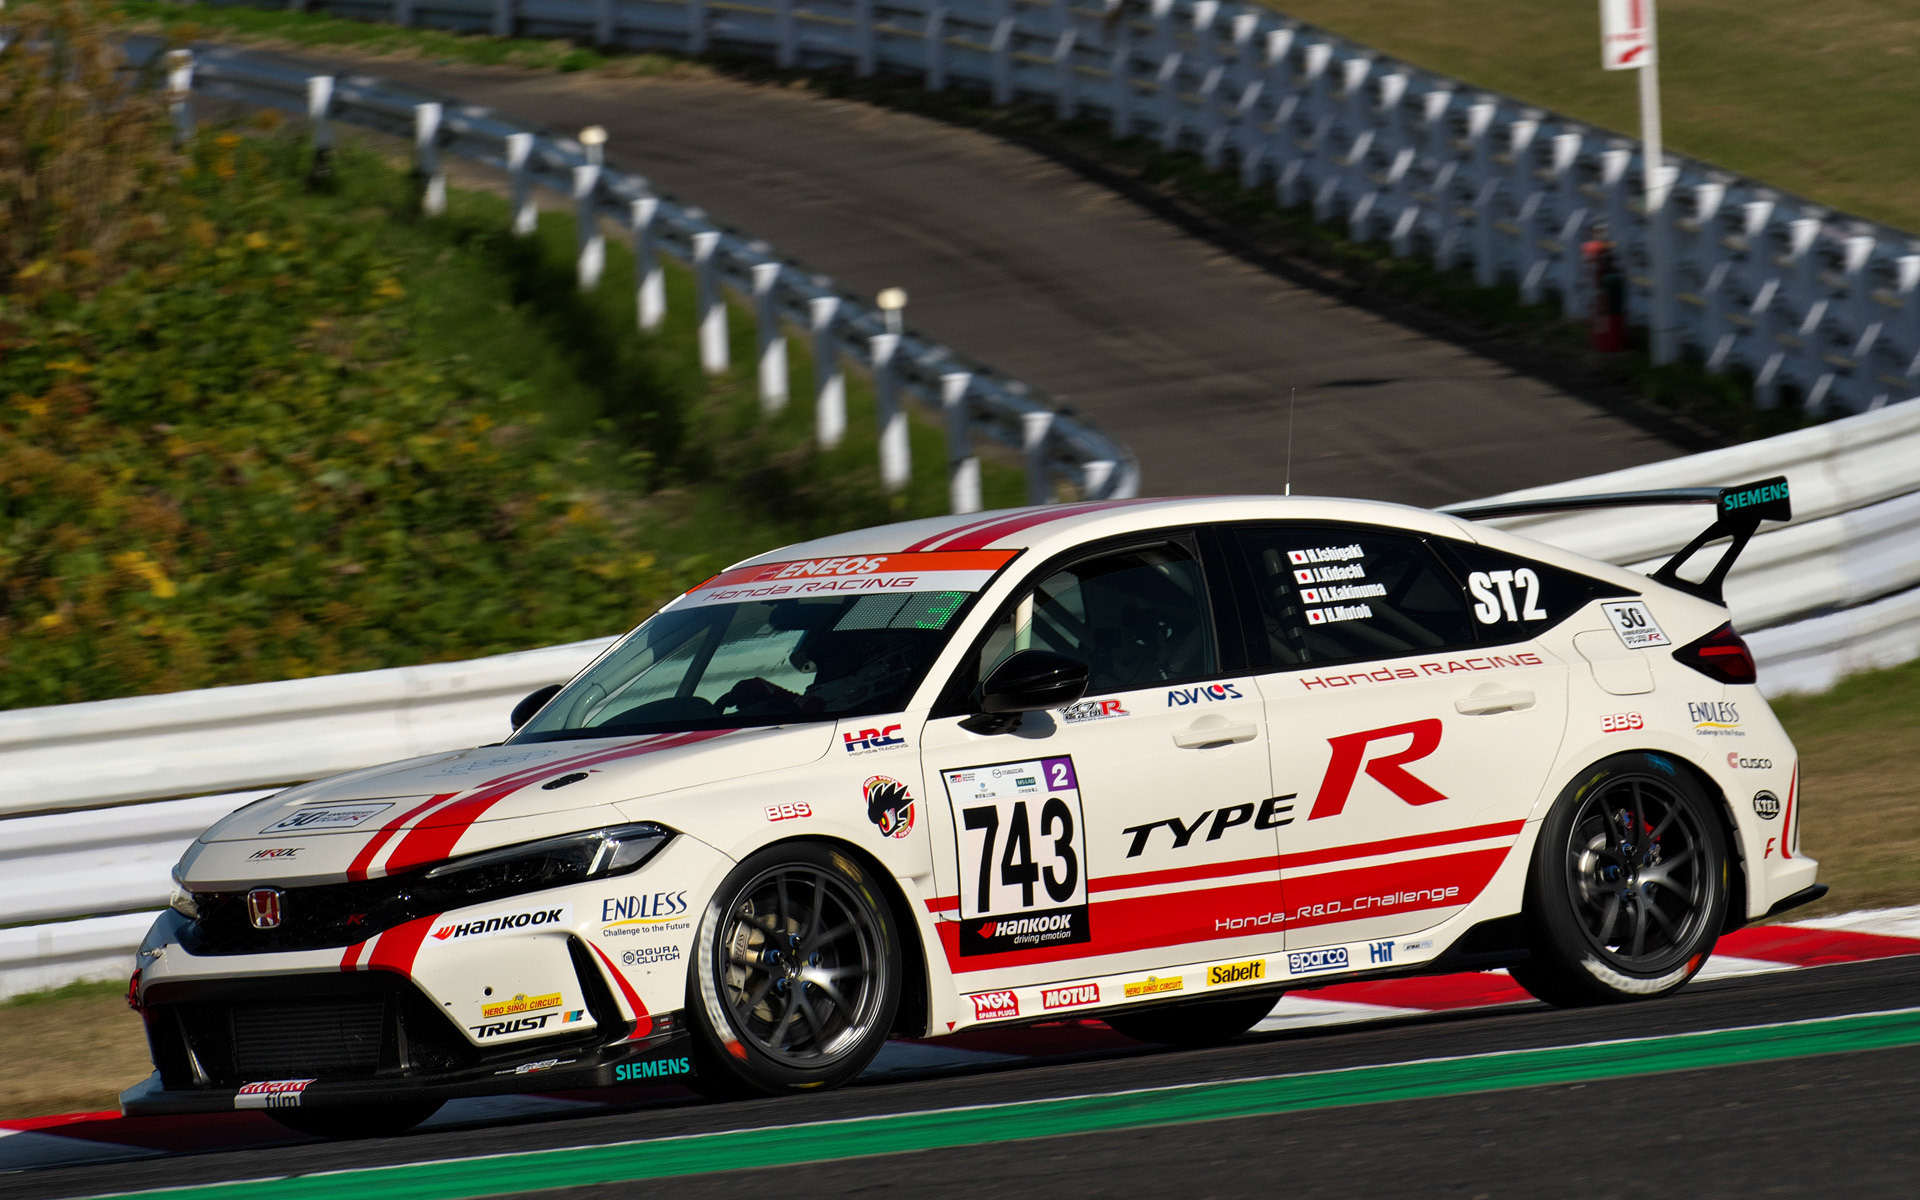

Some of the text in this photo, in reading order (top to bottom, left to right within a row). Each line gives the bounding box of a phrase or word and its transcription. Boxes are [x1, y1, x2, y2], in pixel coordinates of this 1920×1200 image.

[1724, 482, 1789, 511] SIEMENS
[774, 556, 888, 579] ENEOS
[702, 577, 918, 602] Honda RACING
[1468, 567, 1547, 624] ST2
[1300, 653, 1543, 690] Honda RACING
[1600, 711, 1643, 732] BBS
[1688, 701, 1740, 722] ENDLESS
[843, 724, 905, 752] HRC
[1051, 763, 1069, 787] 2
[1122, 718, 1449, 859] TYPE R
[277, 811, 329, 828] 30
[765, 802, 813, 822] BBS
[963, 797, 1078, 914] 743
[602, 890, 687, 922] ENDLESS
[603, 927, 640, 937] Challenge
[666, 923, 690, 931] Future
[1013, 930, 1071, 944] driving emotion
[636, 945, 679, 956] OGURA
[637, 953, 680, 964] CLUTCH
[1290, 948, 1347, 972] sparco
[1211, 961, 1261, 984] Sabelt
[1045, 986, 1097, 1007] MOTUL
[1126, 987, 1141, 995] HERO
[1160, 980, 1182, 990] CIRCUIT
[484, 997, 560, 1017] HERO SINOI CIRCUIT
[974, 992, 1015, 1011] NGK
[470, 1012, 558, 1038] TRUST
[978, 1008, 1016, 1020] SPARK PLUGS
[616, 1057, 690, 1081] SIEMENS
[265, 1091, 300, 1108] film
